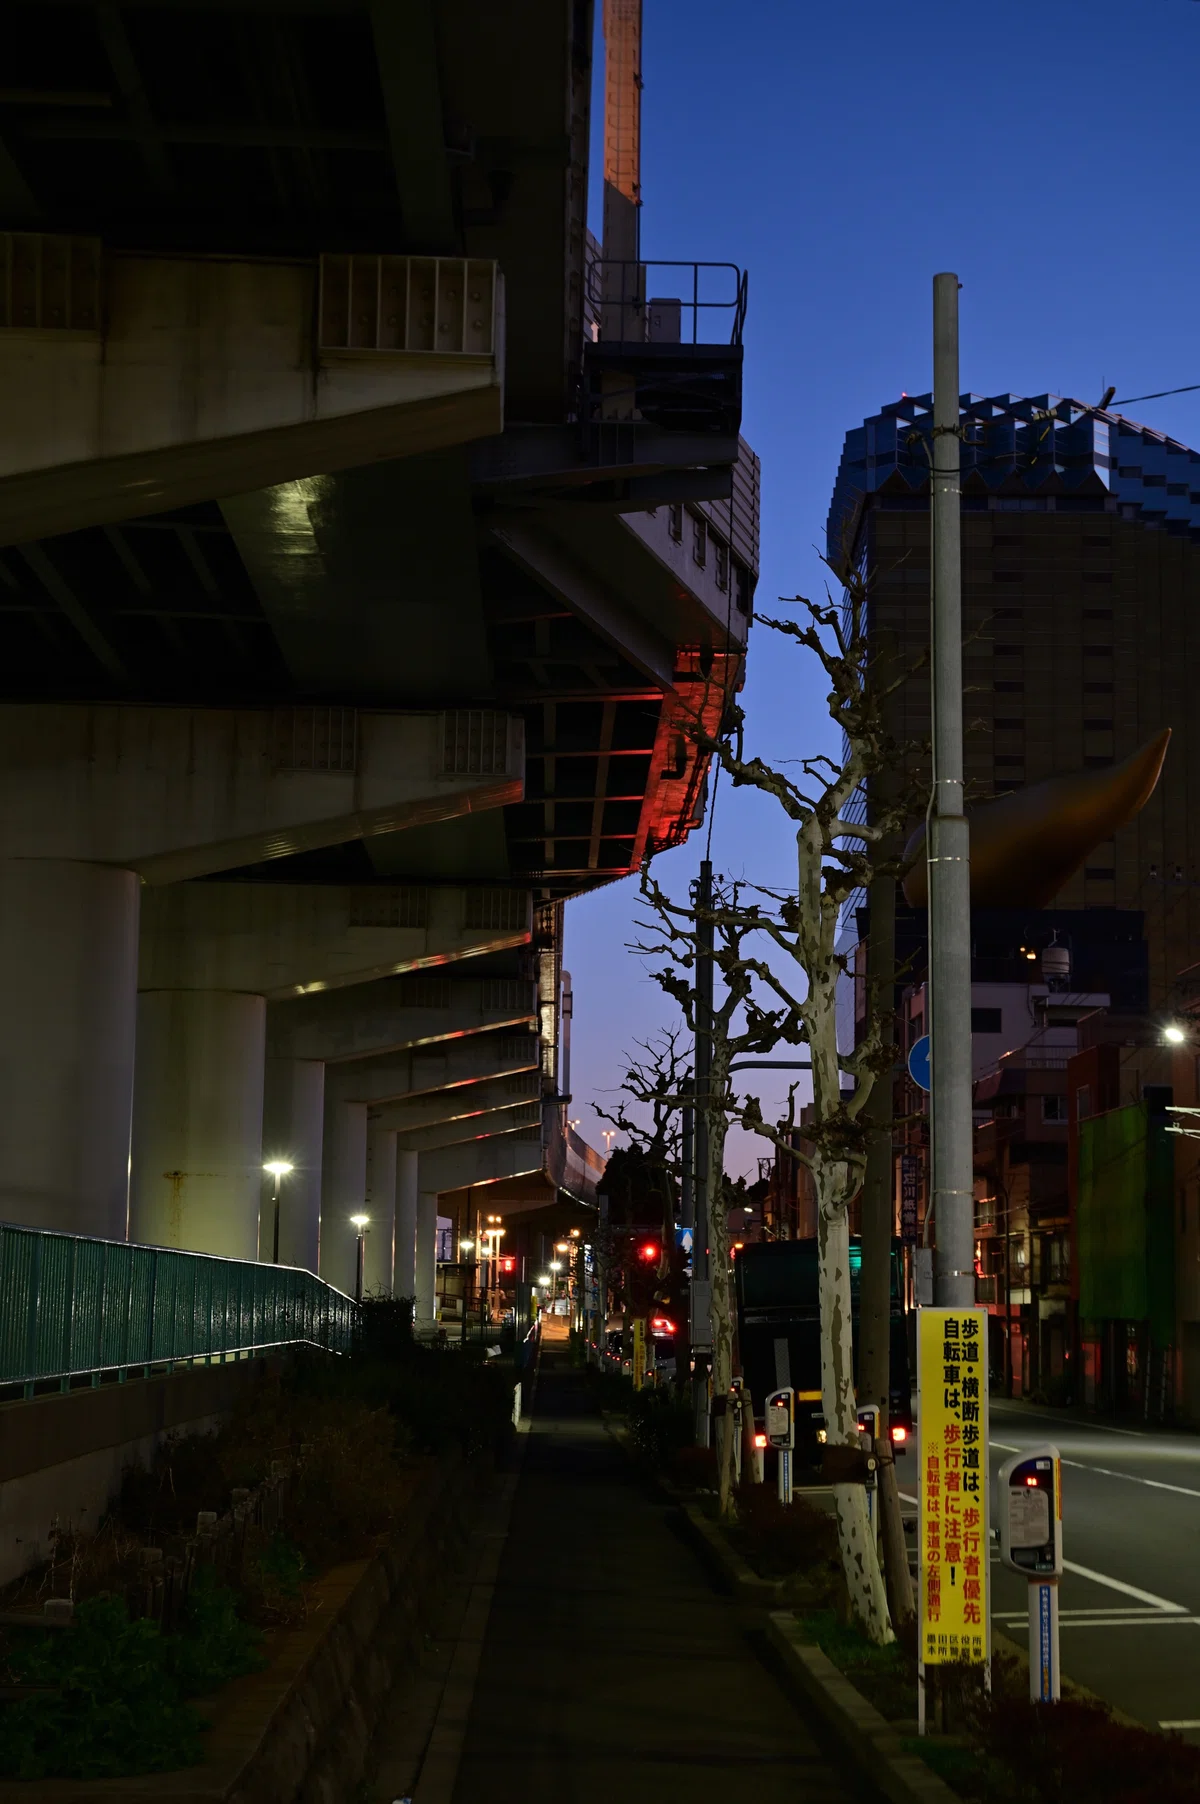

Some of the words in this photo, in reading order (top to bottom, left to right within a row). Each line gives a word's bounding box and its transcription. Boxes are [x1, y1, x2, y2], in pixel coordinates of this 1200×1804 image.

[927, 1441, 940, 1622] ※自転車は、車道の左側通行
[943, 1317, 961, 1586] 自転車は、歩行者に注意！
[961, 1318, 980, 1624] 歩道・横断歩道は、歩行者優先
